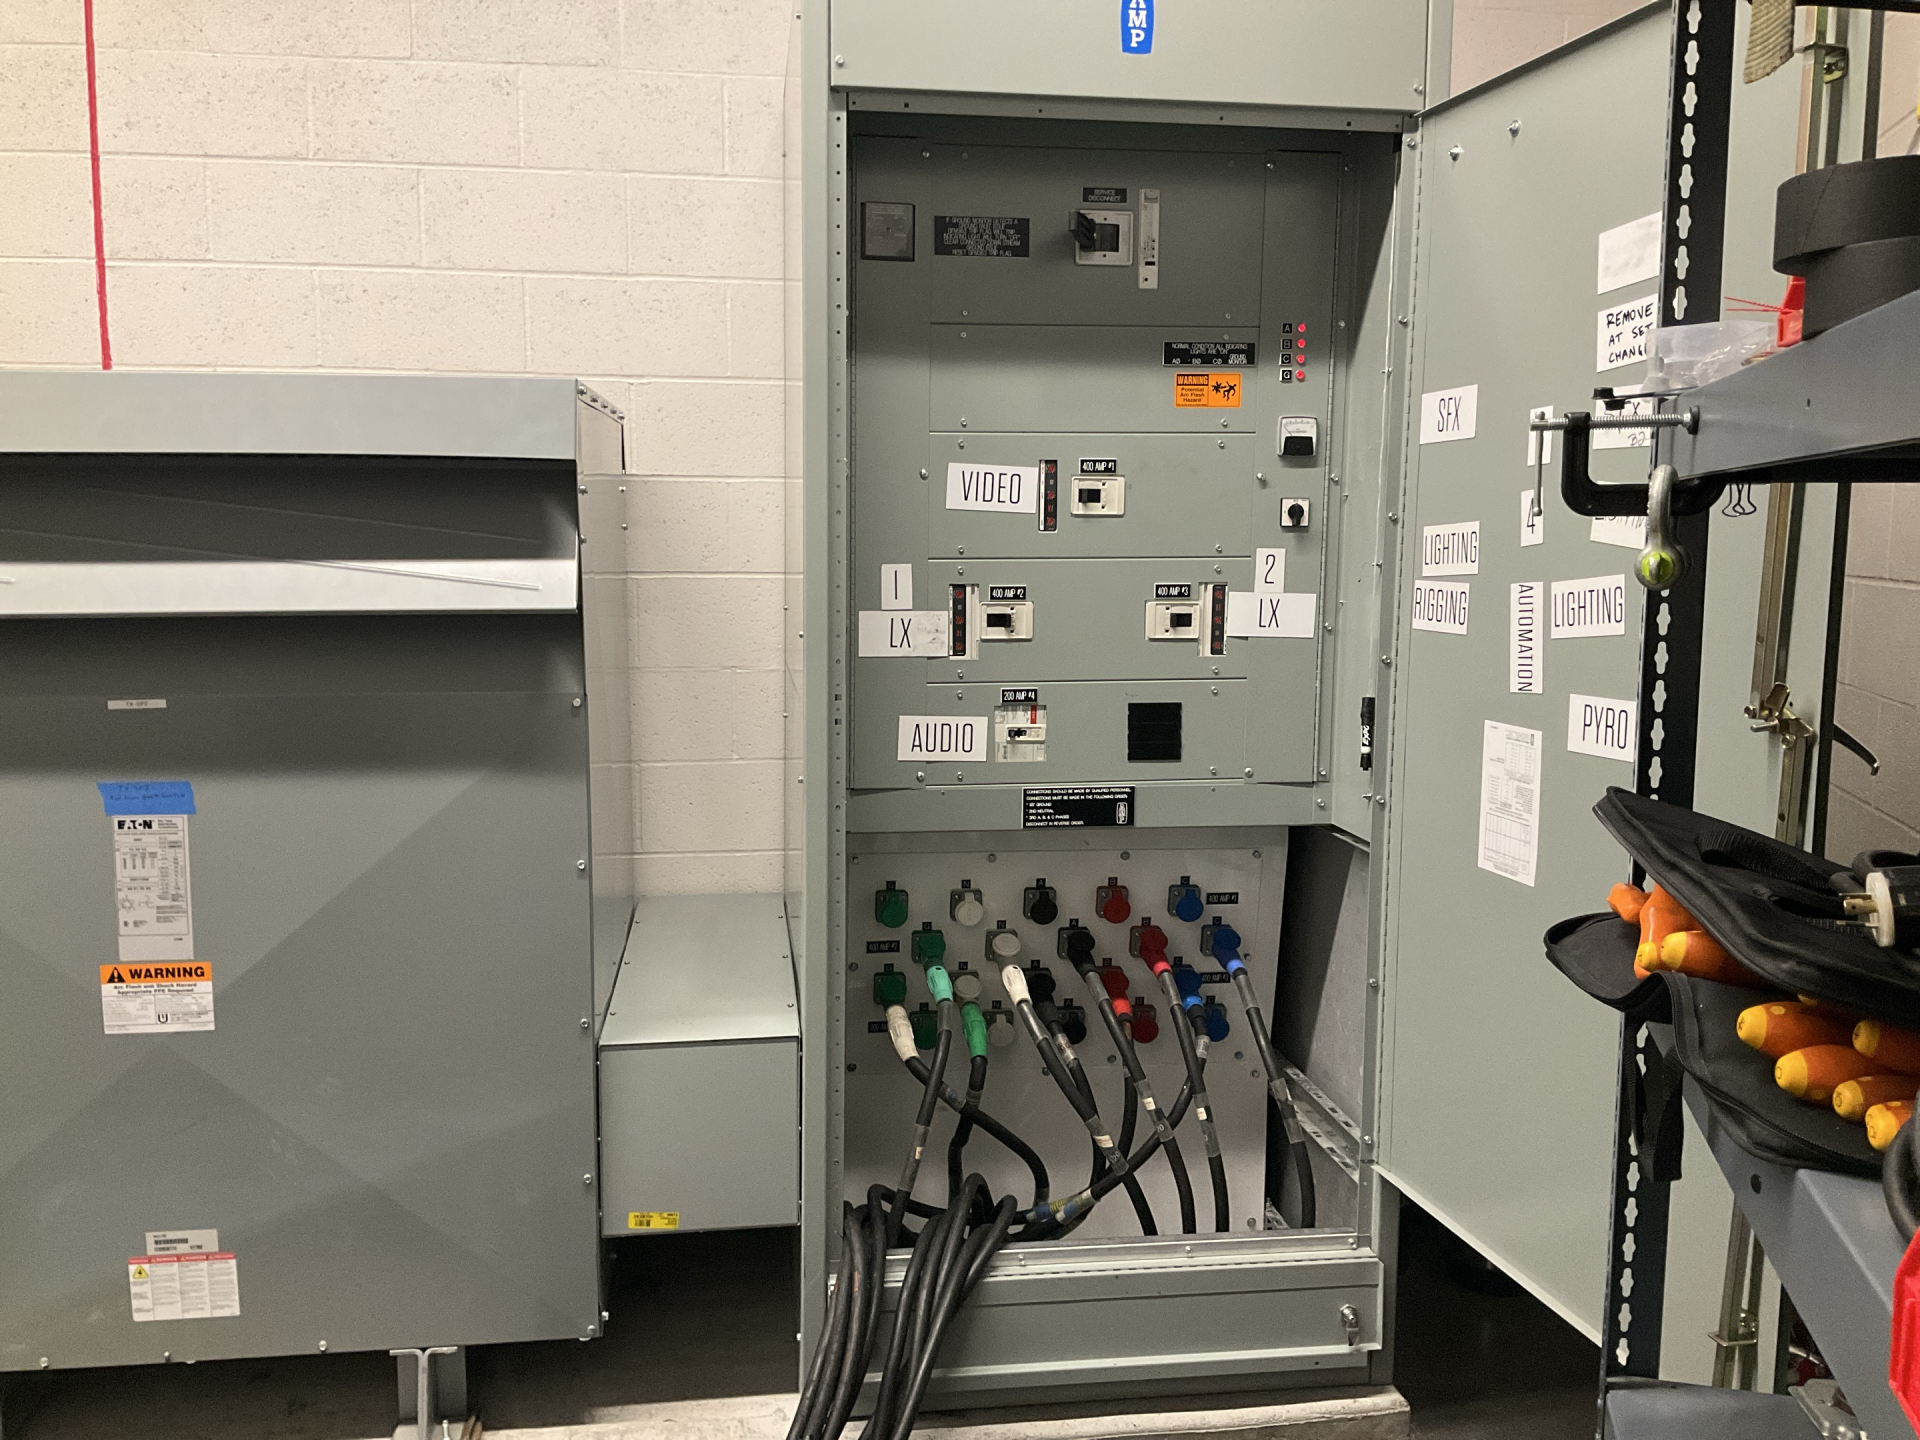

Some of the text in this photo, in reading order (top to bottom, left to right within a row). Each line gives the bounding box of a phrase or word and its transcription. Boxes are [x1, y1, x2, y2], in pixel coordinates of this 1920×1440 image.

[1606, 302, 1654, 328] REMOVE
[1608, 332, 1623, 346] AT
[1608, 343, 1647, 363] CHANG
[1177, 376, 1208, 385] WARNING
[1437, 396, 1462, 433] SFX
[1083, 462, 1115, 471] 400 AMP #1
[962, 470, 1022, 504] VIDEO
[1527, 498, 1535, 534] 4
[1424, 531, 1477, 566] LIGHTING
[1264, 554, 1276, 584] 2
[992, 588, 1024, 598] 400 AMP #2
[1158, 587, 1189, 596] 400 AMP #3
[1258, 598, 1280, 628] LX
[1414, 588, 1467, 626] RIGGING
[1554, 586, 1623, 628] LIGHTING
[890, 618, 912, 648] LX
[1518, 584, 1534, 692] AUTOMATION
[1004, 691, 1035, 700] 200 AMP #4
[911, 723, 973, 753] AUDIO
[1582, 704, 1628, 749] PYRO
[118, 820, 152, 829] EATON
[129, 966, 205, 979] WARNING
